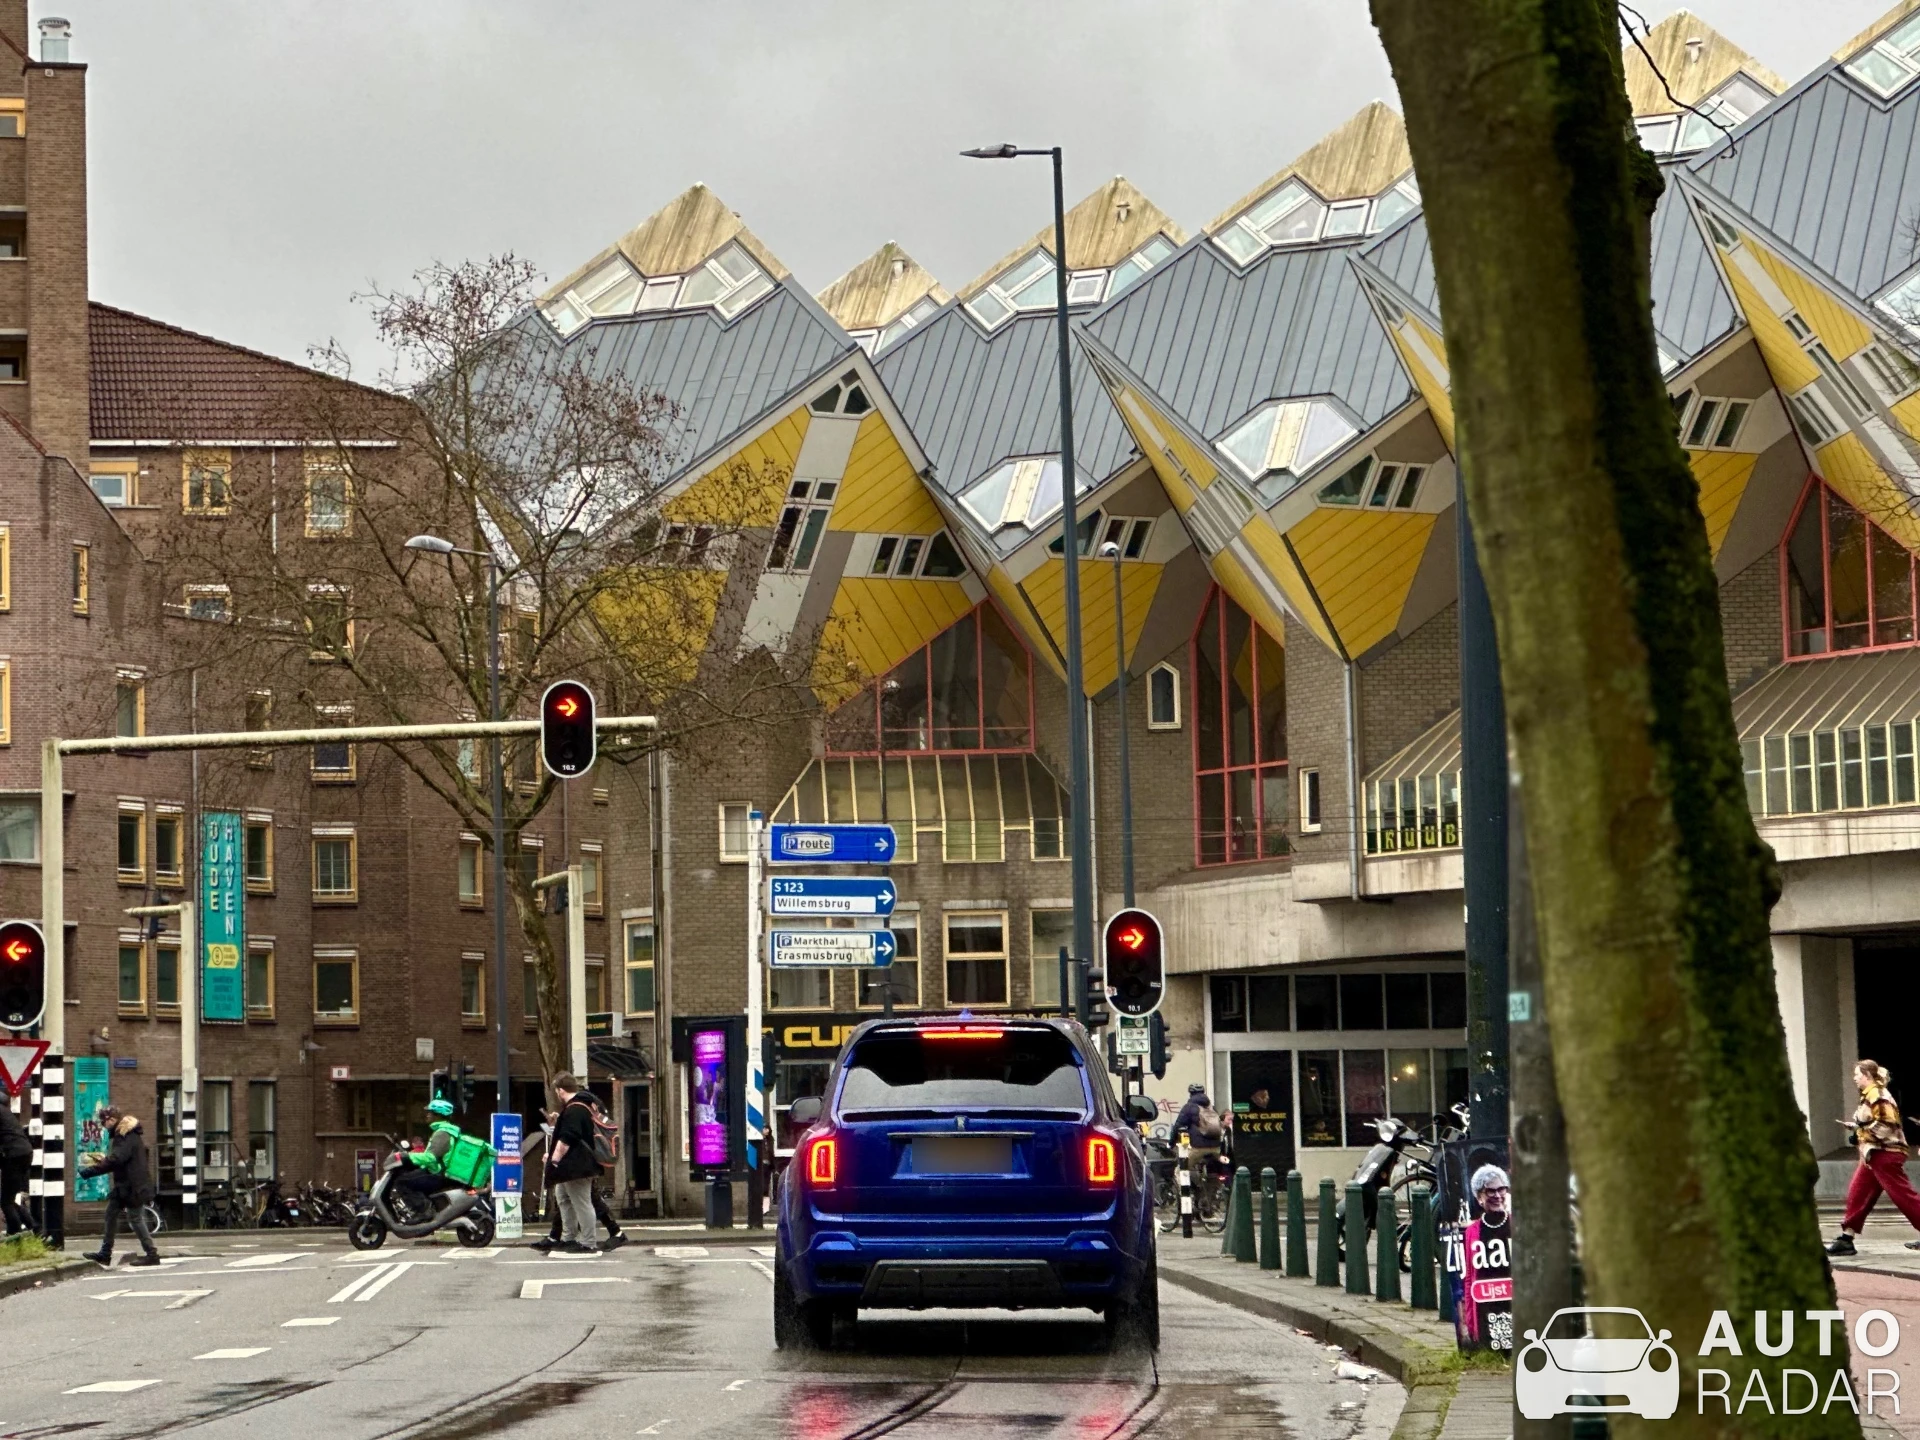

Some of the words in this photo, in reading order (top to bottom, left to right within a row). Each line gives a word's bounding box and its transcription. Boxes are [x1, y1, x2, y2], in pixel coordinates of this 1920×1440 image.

[800, 840, 831, 849] route
[210, 821, 219, 911] OUDE
[225, 822, 235, 935] HAVEN
[774, 882, 782, 892] S
[784, 882, 804, 892] 123
[777, 898, 851, 910] Willemsbrug
[793, 937, 839, 946] Markthal
[777, 951, 853, 962] Erasmusbrug
[1440, 1234, 1467, 1280] Zij
[1471, 1238, 1513, 1270] aa
[1481, 1284, 1507, 1299] Lijst
